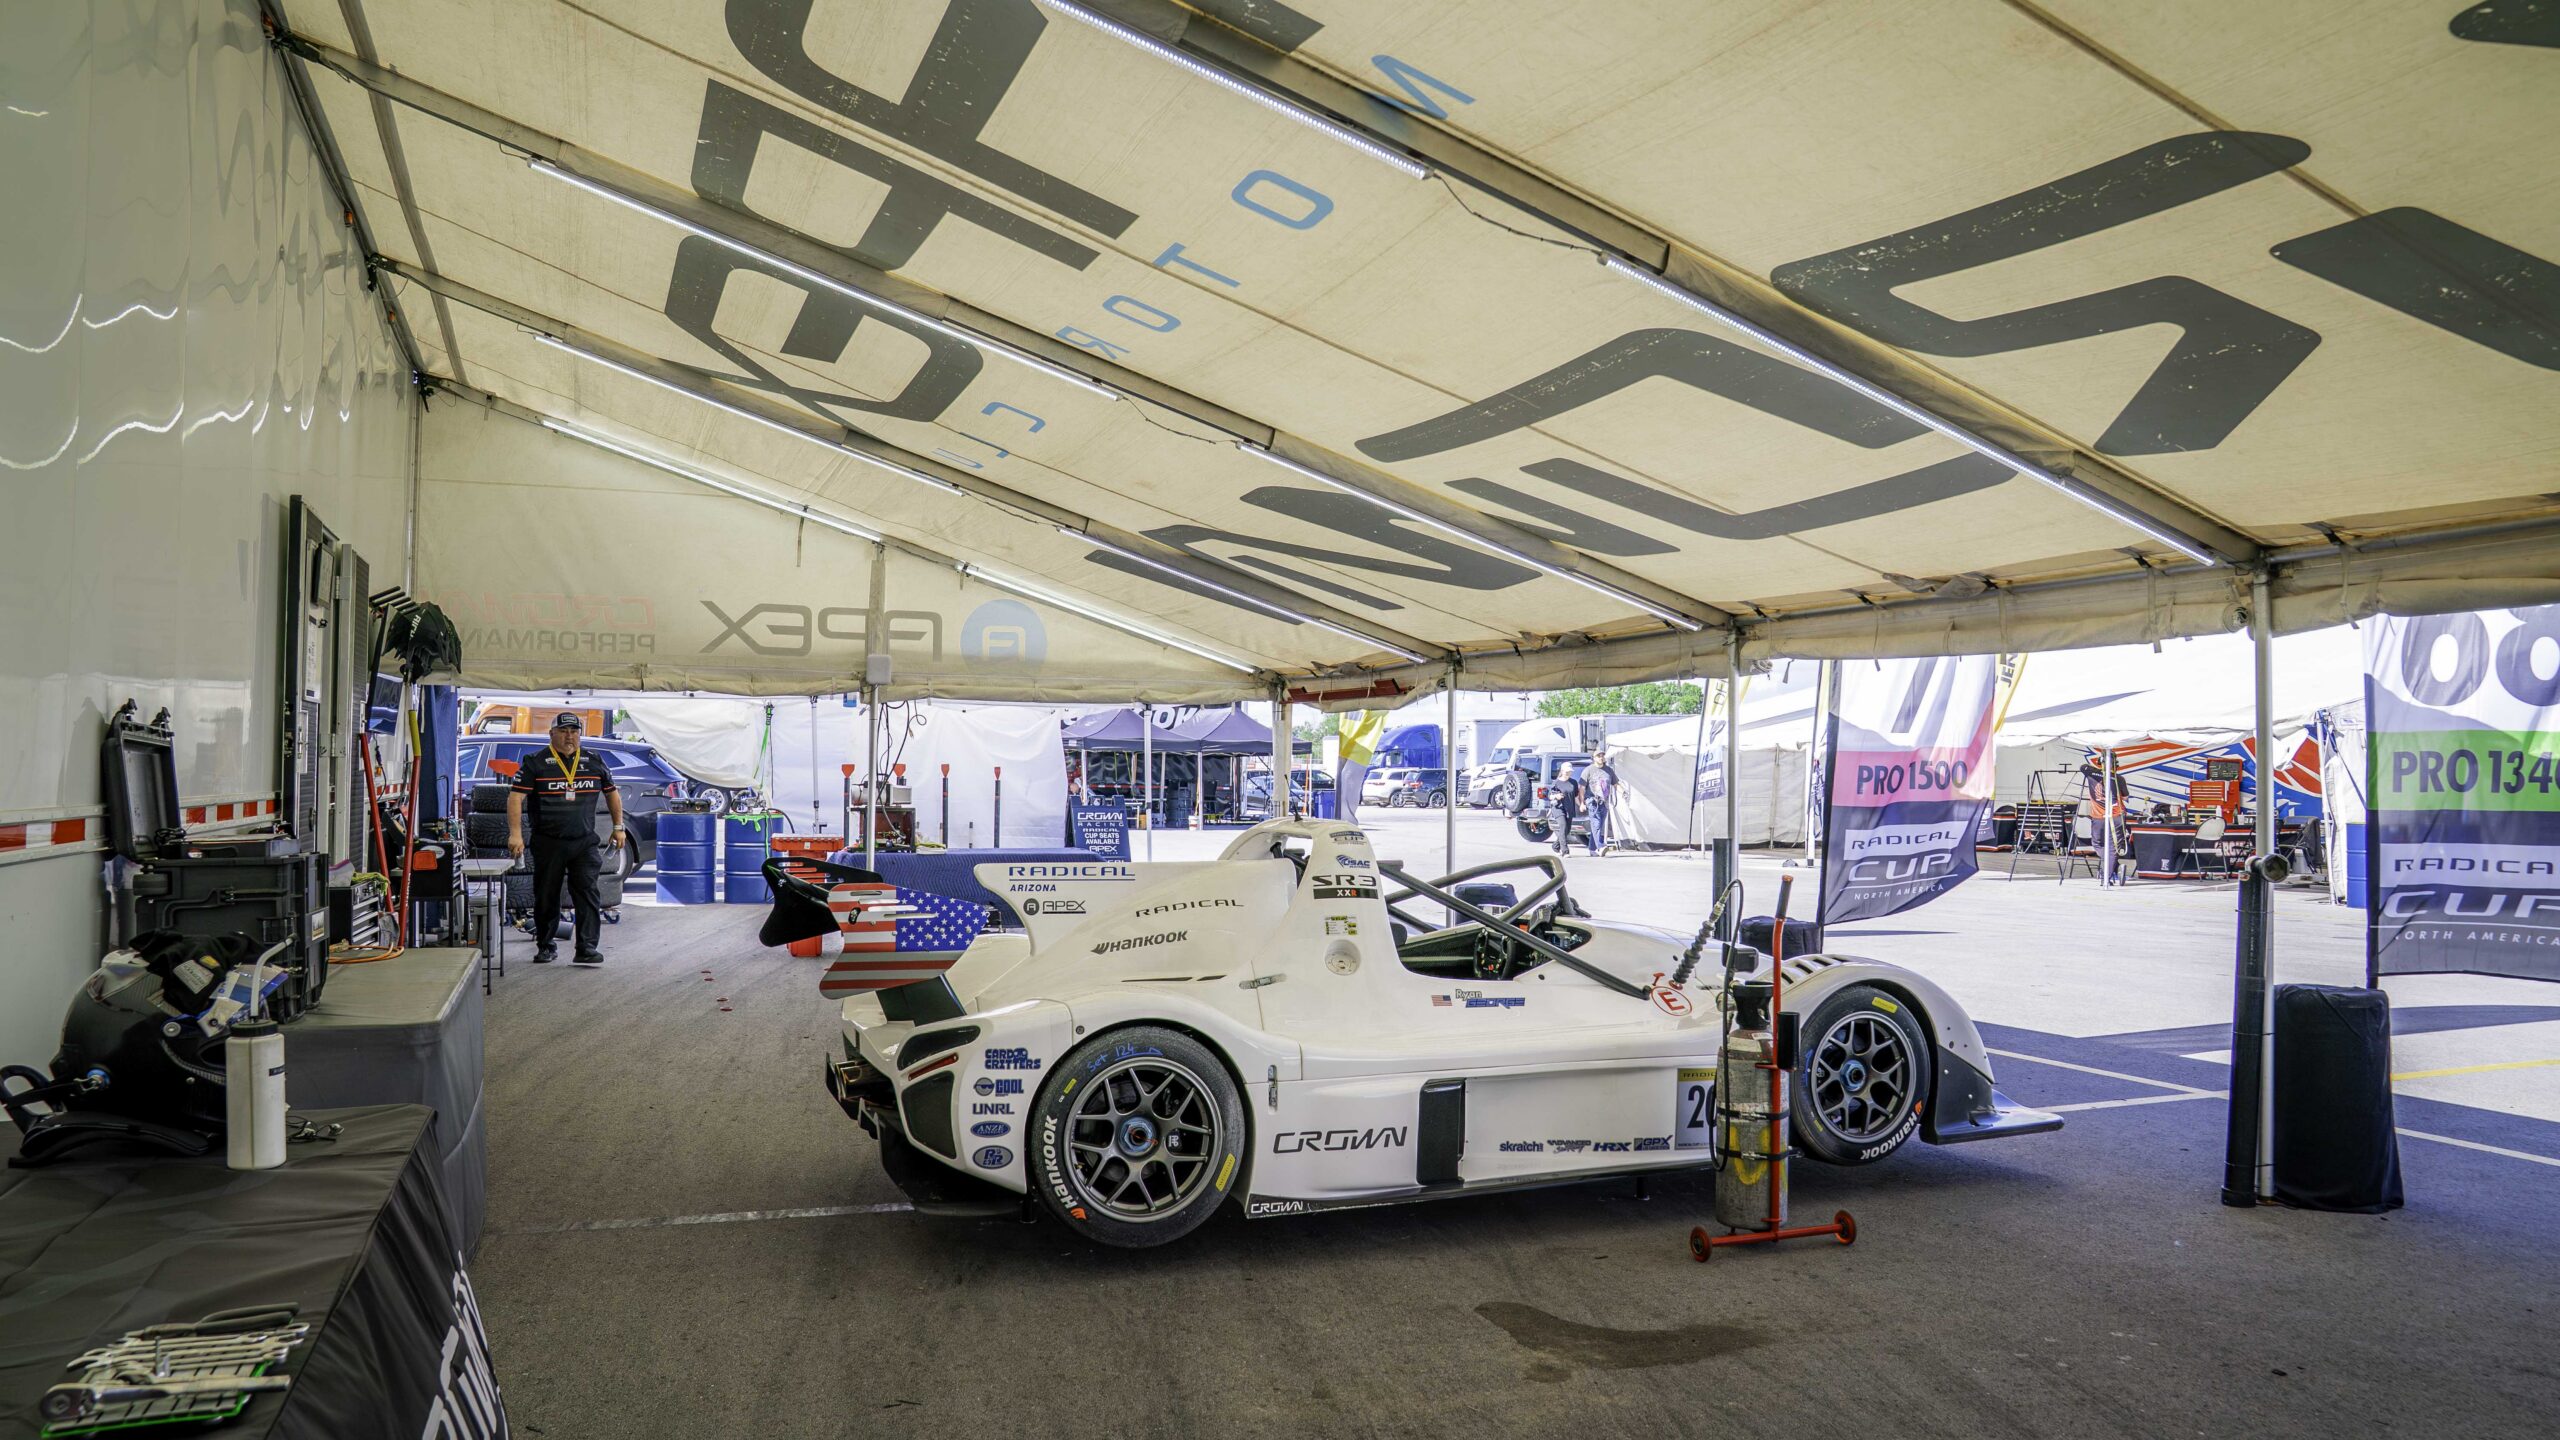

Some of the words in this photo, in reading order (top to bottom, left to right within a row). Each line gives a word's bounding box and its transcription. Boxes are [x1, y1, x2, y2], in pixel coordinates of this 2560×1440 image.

[1857, 765, 1905, 795] PRO
[1909, 760, 1968, 791] 1500
[2393, 749, 2479, 793] PRO
[2489, 750, 2560, 794] 134
[1077, 812, 1123, 820] CROWN
[1852, 830, 1958, 850] RADICAL
[1008, 866, 1136, 877] RADICAL
[1848, 853, 1952, 882] CUP
[1312, 874, 1377, 887] SR3
[1009, 884, 1057, 892] ARIZONA
[1337, 889, 1358, 897] XXR
[1854, 890, 1891, 900] NORTH
[1896, 884, 1944, 896] AMERICA
[1042, 900, 1086, 911] APEX
[1135, 898, 1245, 918] RADICAL
[2395, 930, 2453, 940] ORTH
[1455, 989, 1483, 1001] Ryan
[984, 1058, 1041, 1070] CRITTERS
[995, 1079, 1024, 1094] COOL
[972, 1103, 1015, 1115] UNRL
[977, 1124, 1005, 1132] ANZE
[1273, 1126, 1408, 1154] CROWN
[1499, 1140, 1540, 1152] skratch
[1593, 1142, 1632, 1152] HRX
[1643, 1134, 1673, 1146] GPX
[1250, 1201, 1304, 1214] CROWN
